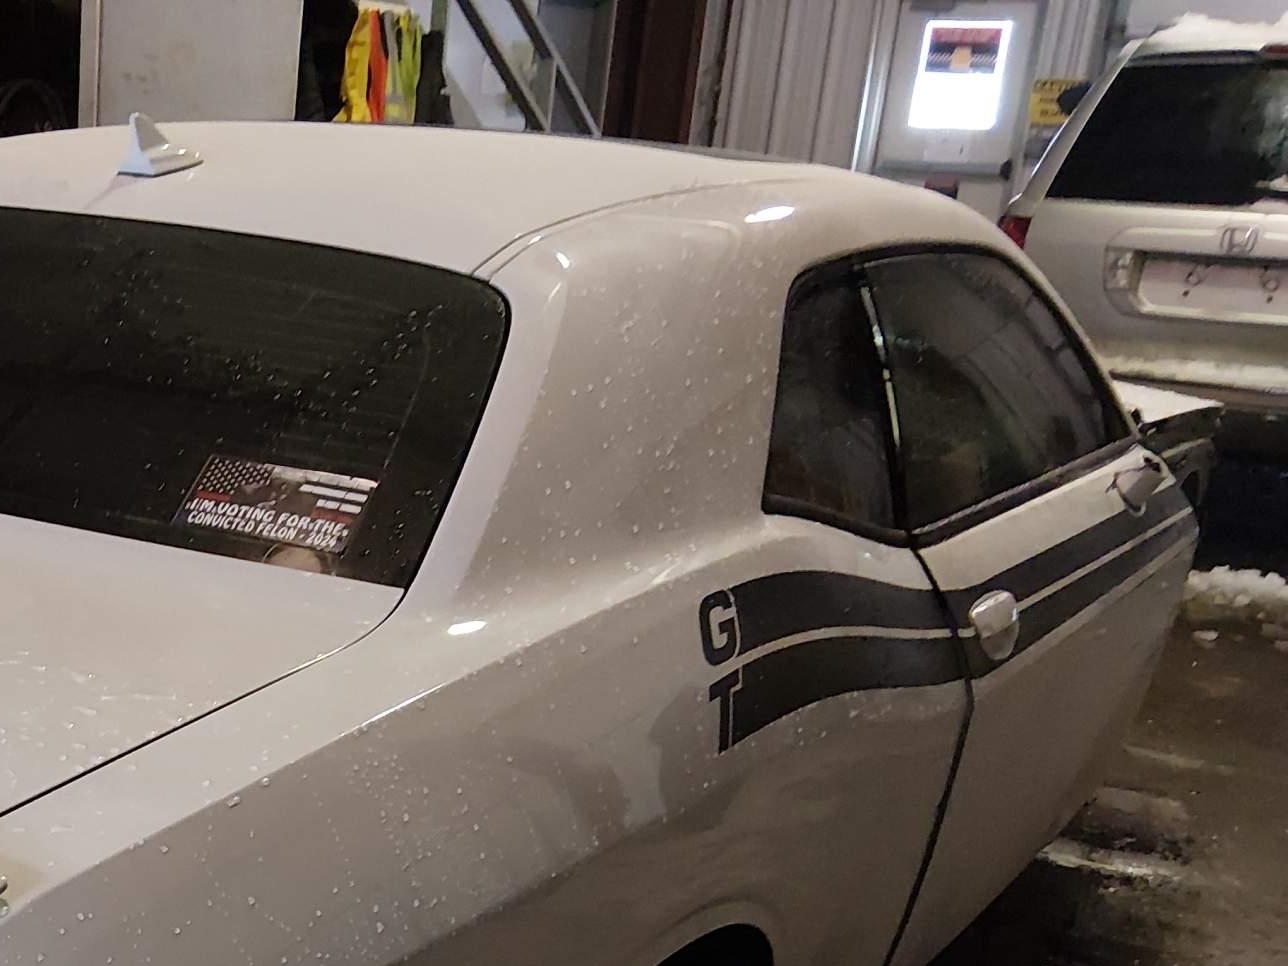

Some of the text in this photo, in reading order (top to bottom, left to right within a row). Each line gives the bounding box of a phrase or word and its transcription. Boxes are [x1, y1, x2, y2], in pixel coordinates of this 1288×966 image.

[187, 510, 255, 533] CONVICTED
[255, 522, 299, 541] FELON
[305, 531, 338, 548] 2024
[217, 501, 276, 522] VOTING
[276, 512, 312, 530] FOR
[312, 518, 346, 536] THE
